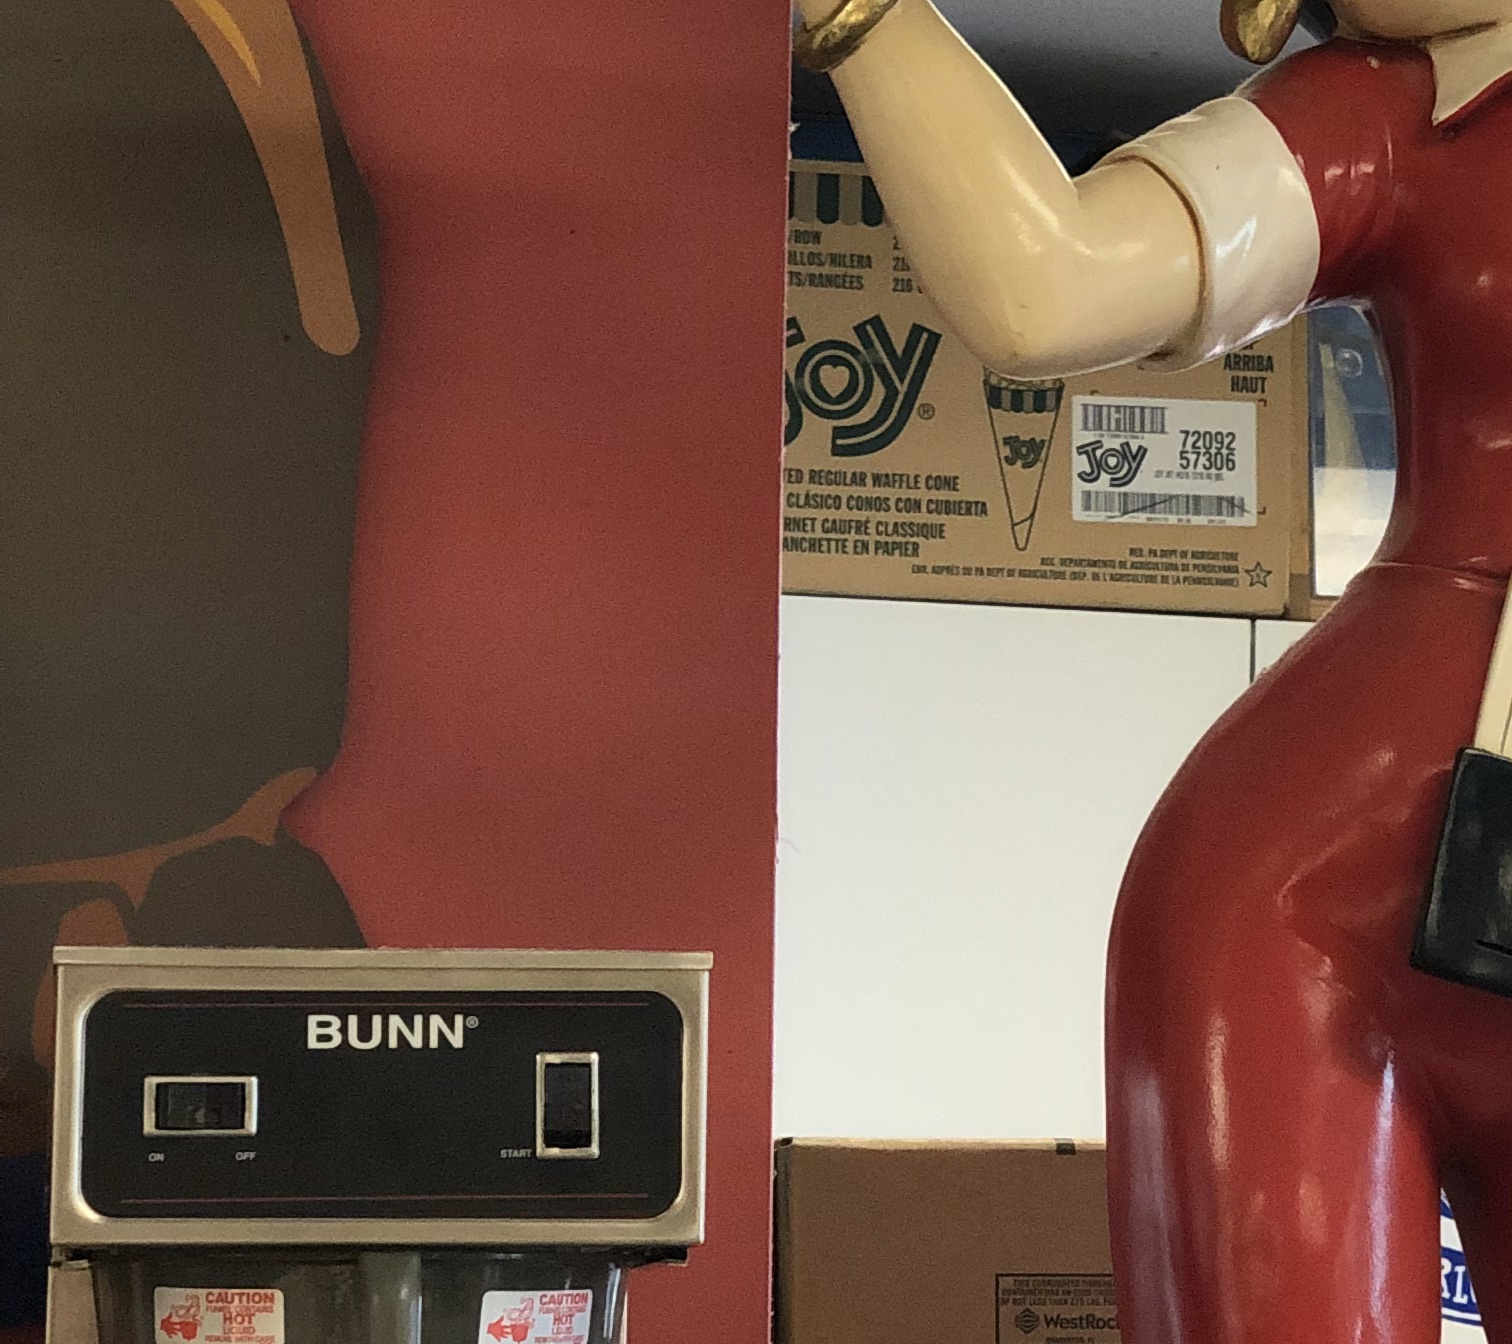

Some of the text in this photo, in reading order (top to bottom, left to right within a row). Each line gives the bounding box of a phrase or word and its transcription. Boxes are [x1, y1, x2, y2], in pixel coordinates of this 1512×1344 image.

[1223, 353, 1274, 374] ARRIBA
[1231, 376, 1267, 394] HAUT
[1179, 430, 1236, 452] 72092
[1179, 451, 1236, 472] 57306
[808, 468, 868, 488] REGULAR
[871, 472, 921, 491] WAFFLE
[925, 474, 961, 492] CONE
[786, 490, 989, 517] CLÁSICO CONOS CON CUBIERTA
[783, 517, 946, 540] RNET GAUFRÉ CLASSIQUE
[782, 536, 920, 558] ANCHETTE EN PAPIER
[307, 1014, 464, 1050] BUNN
[148, 1151, 256, 1162] ON OFF
[500, 1149, 532, 1159] START
[205, 1292, 275, 1304] CAUTION
[539, 1293, 588, 1306] CAUTION
[223, 1312, 256, 1325] HOT
[553, 1314, 574, 1326] HOT
[1044, 1313, 1119, 1329] WestRoc
